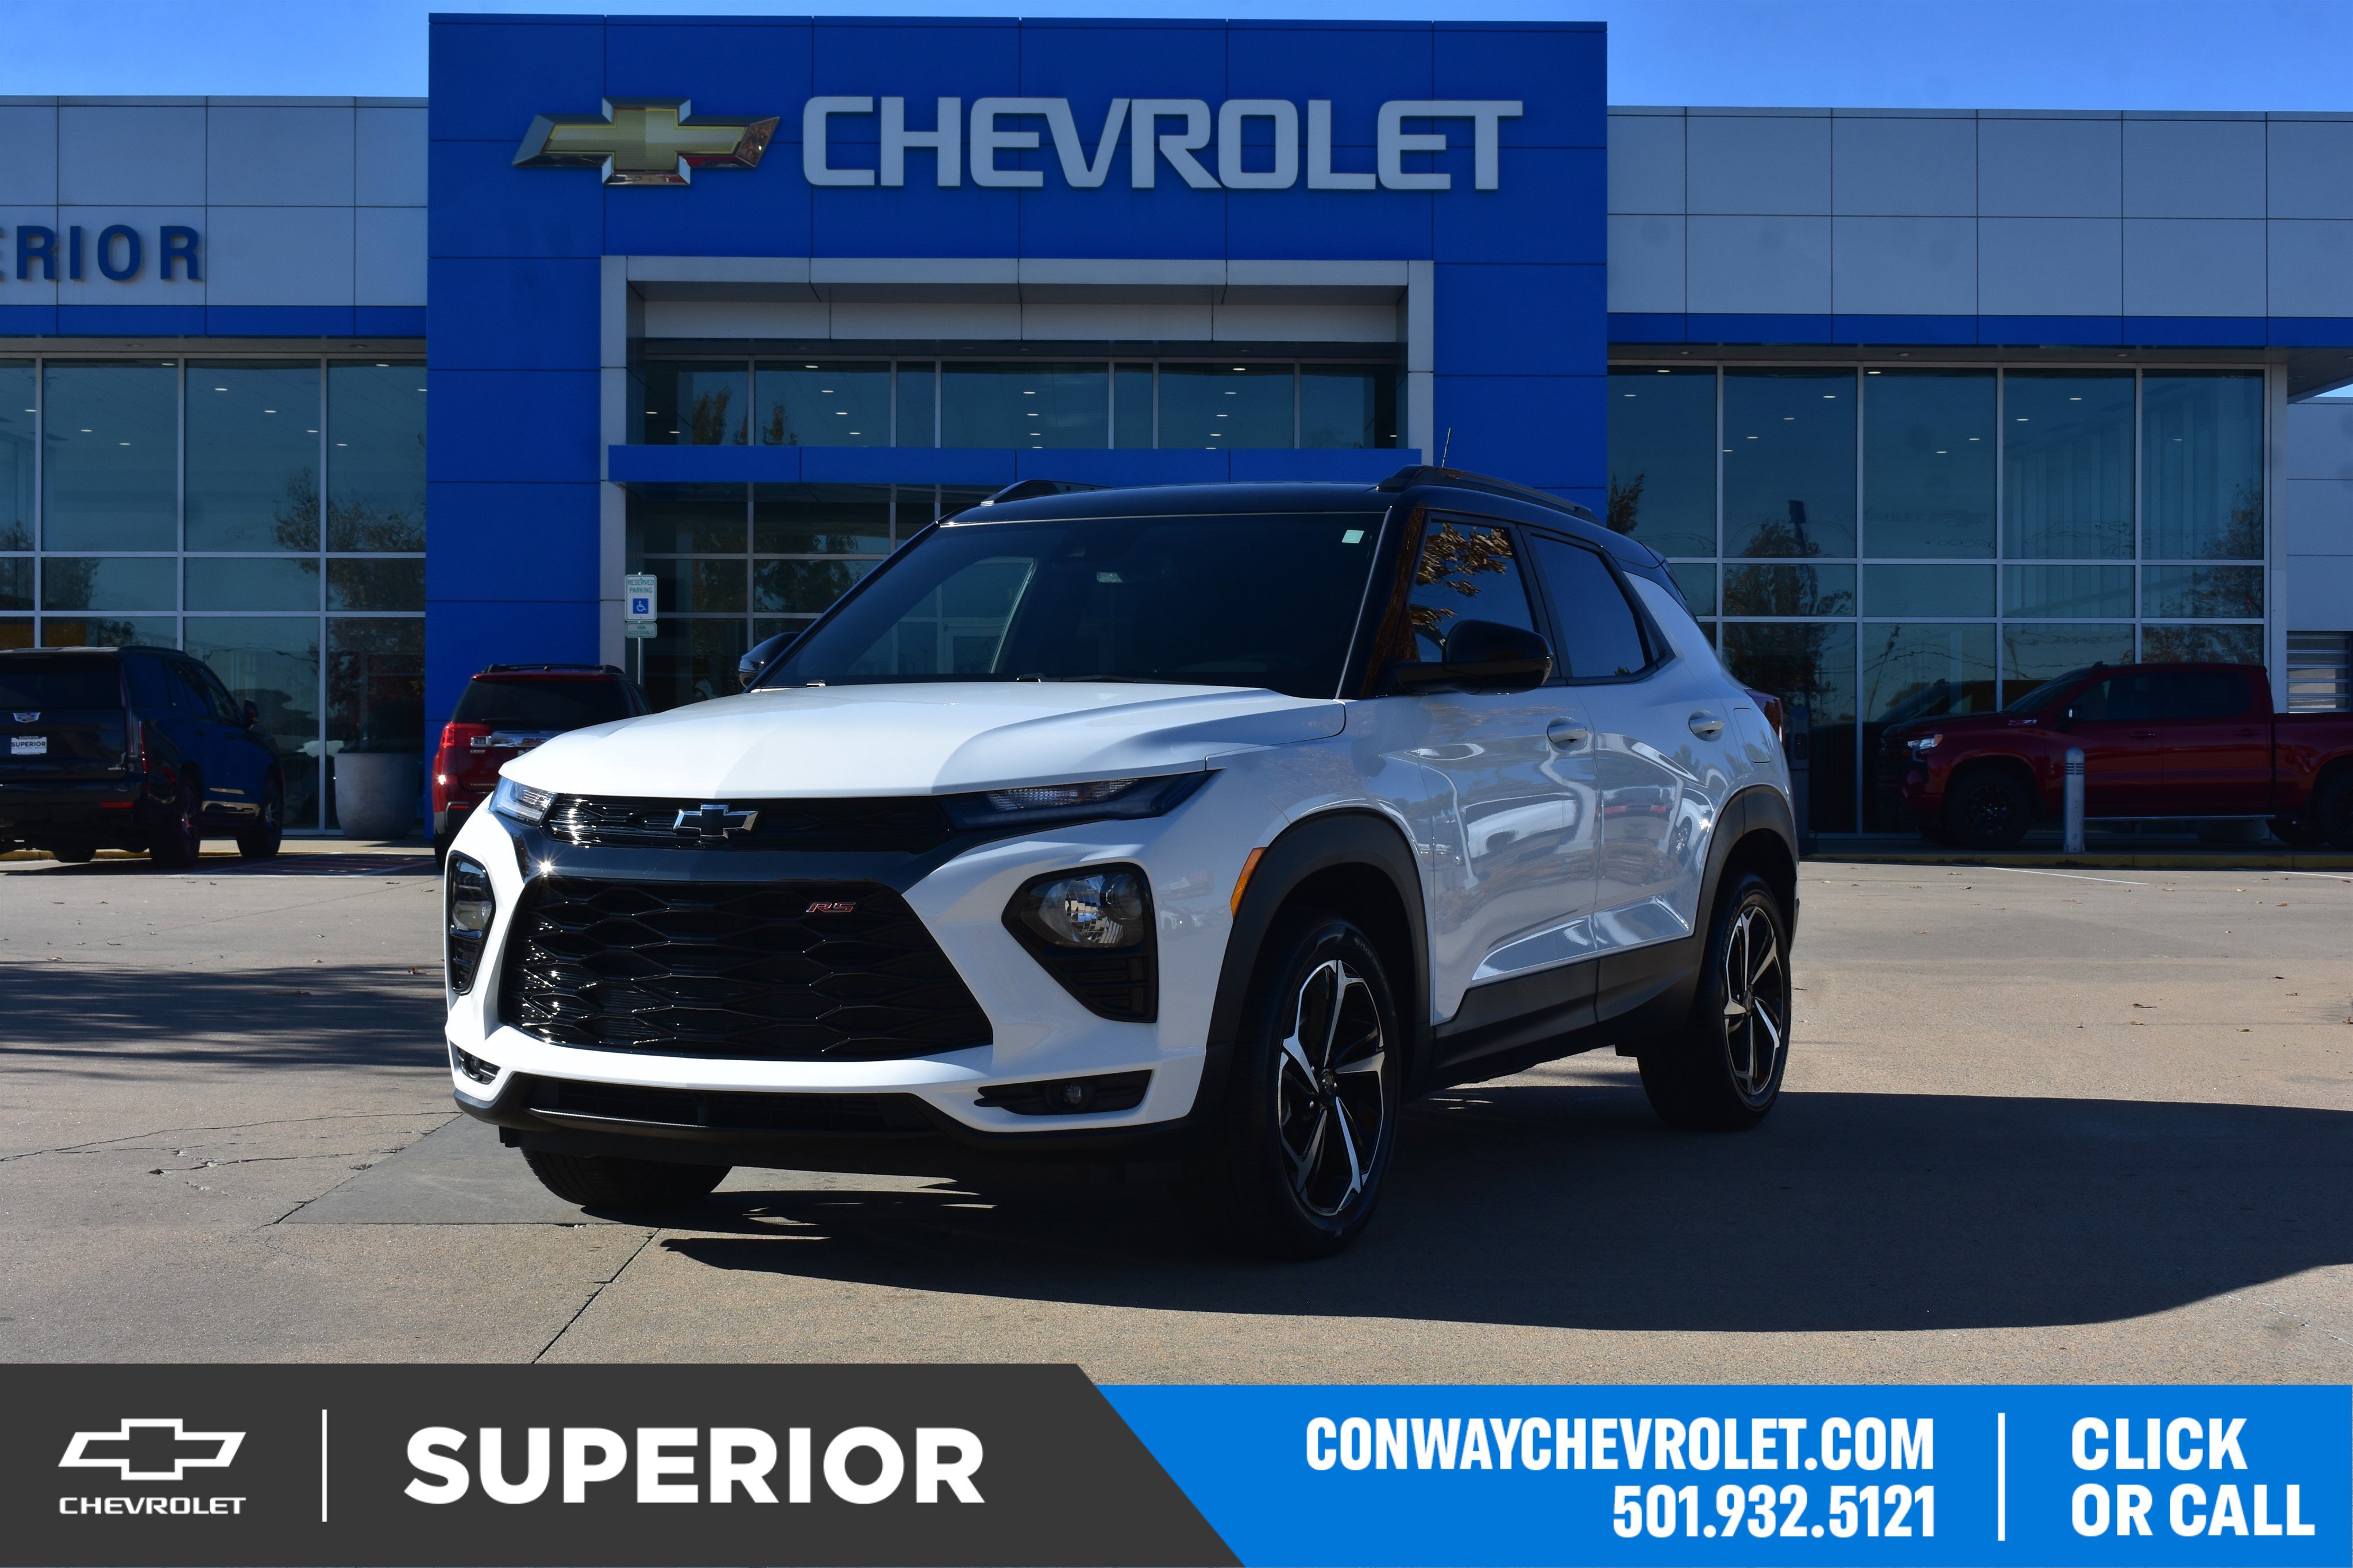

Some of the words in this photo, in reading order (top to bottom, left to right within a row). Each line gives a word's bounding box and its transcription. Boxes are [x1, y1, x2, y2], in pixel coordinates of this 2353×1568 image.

[802, 96, 1523, 190] CHEVROLET
[0, 223, 202, 281] RIOR
[805, 902, 856, 913] RS
